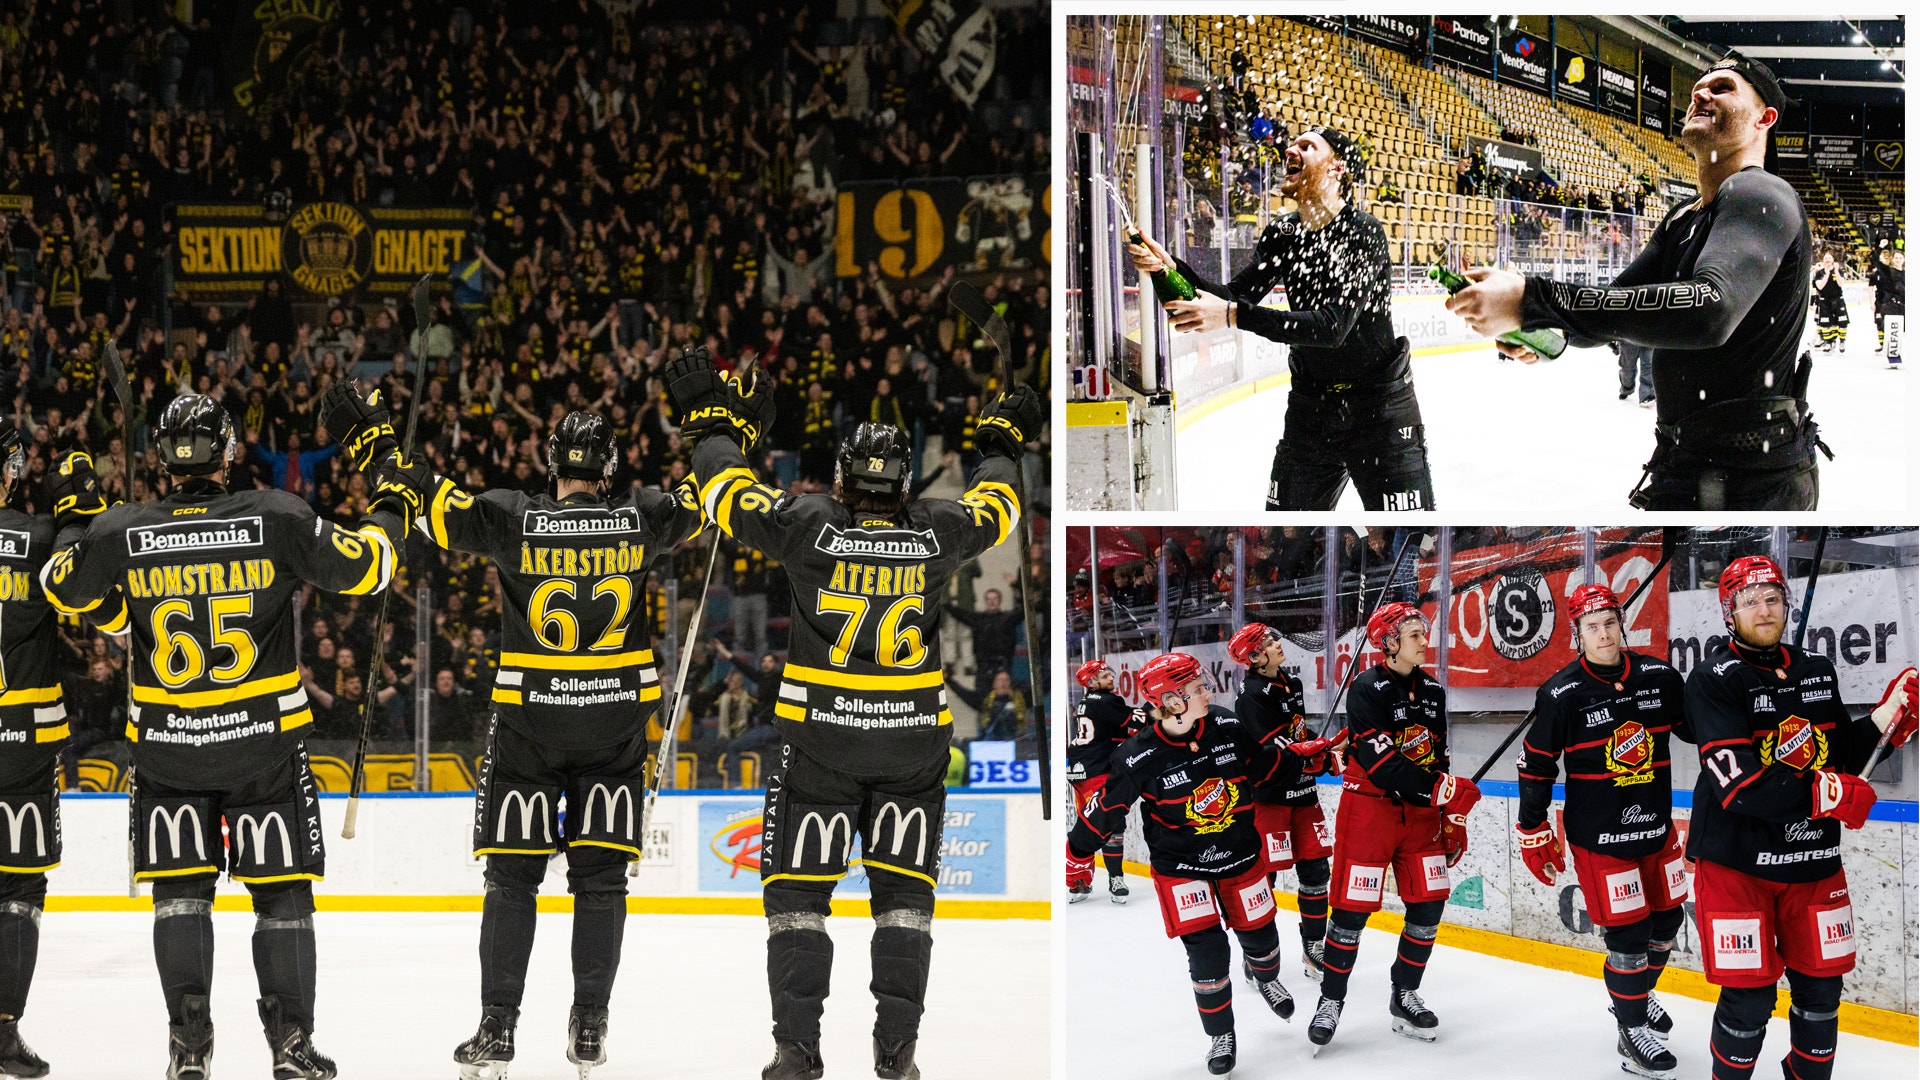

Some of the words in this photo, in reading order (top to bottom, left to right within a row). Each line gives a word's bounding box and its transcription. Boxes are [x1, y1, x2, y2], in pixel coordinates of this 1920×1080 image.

[1501, 52, 1547, 78] VentPartner
[292, 202, 366, 237] SEKTION
[179, 226, 282, 275] SEKTION
[374, 228, 467, 275] GNAGET
[293, 264, 362, 295] GNAGET
[1889, 321, 1900, 357] ALFAB
[176, 446, 193, 459] 65
[568, 449, 583, 462] 62
[868, 457, 883, 470] 76
[172, 507, 208, 516] CCM
[533, 512, 631, 533] Bemannia
[862, 519, 895, 528] CCM
[139, 523, 252, 552] Bemannia
[825, 535, 931, 557] Bemannia
[520, 541, 645, 577] ÅKERSTRÖM
[127, 558, 275, 598] BLOMSTRAND
[829, 561, 926, 596] ATERIUS
[527, 575, 633, 652] 62
[151, 592, 258, 688] 65
[816, 588, 929, 669] 76
[550, 677, 621, 692] Sollentuna
[1777, 686, 1796, 694] CCM
[833, 696, 915, 715] Sollentuna
[145, 718, 275, 746] Emballagehantering
[166, 709, 249, 730] Sollentuna
[811, 708, 937, 730] Emballagehantering
[1615, 730, 1645, 758] ALMTUNA
[1637, 743, 1646, 757] S
[1777, 726, 1812, 758] ALMTUNA
[1803, 743, 1811, 759] S
[1621, 775, 1651, 785] UPPSALA
[1706, 748, 1744, 789] 17
[1195, 782, 1225, 813] ALMTUNA
[764, 775, 782, 866] JÄRFÄLLA
[1785, 818, 1824, 843] Gimo
[307, 816, 321, 856] KÖK
[1730, 1055, 1753, 1063] CCM
[1811, 1047, 1833, 1055] CCM
